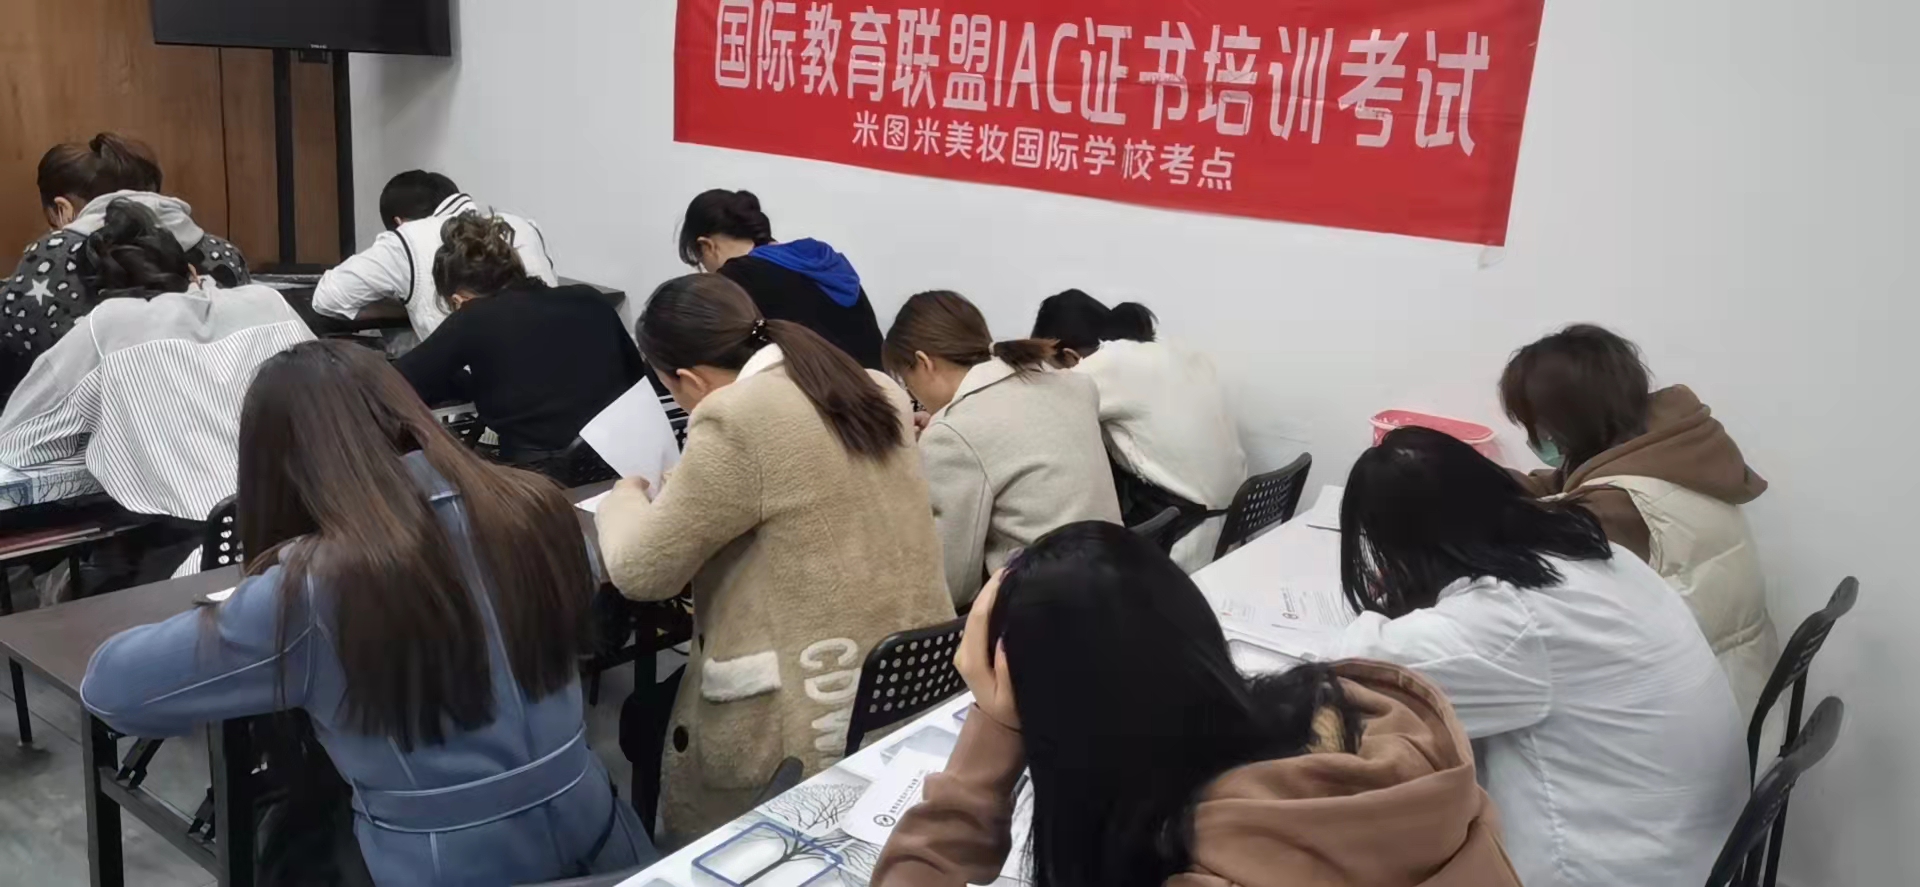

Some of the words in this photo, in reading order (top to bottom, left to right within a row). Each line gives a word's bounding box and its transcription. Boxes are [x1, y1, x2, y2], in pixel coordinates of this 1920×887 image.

[715, 0, 1490, 157] 国际教育联盟IAC证书培训考试
[852, 110, 1235, 191] 米图米美妆国际学校考点
